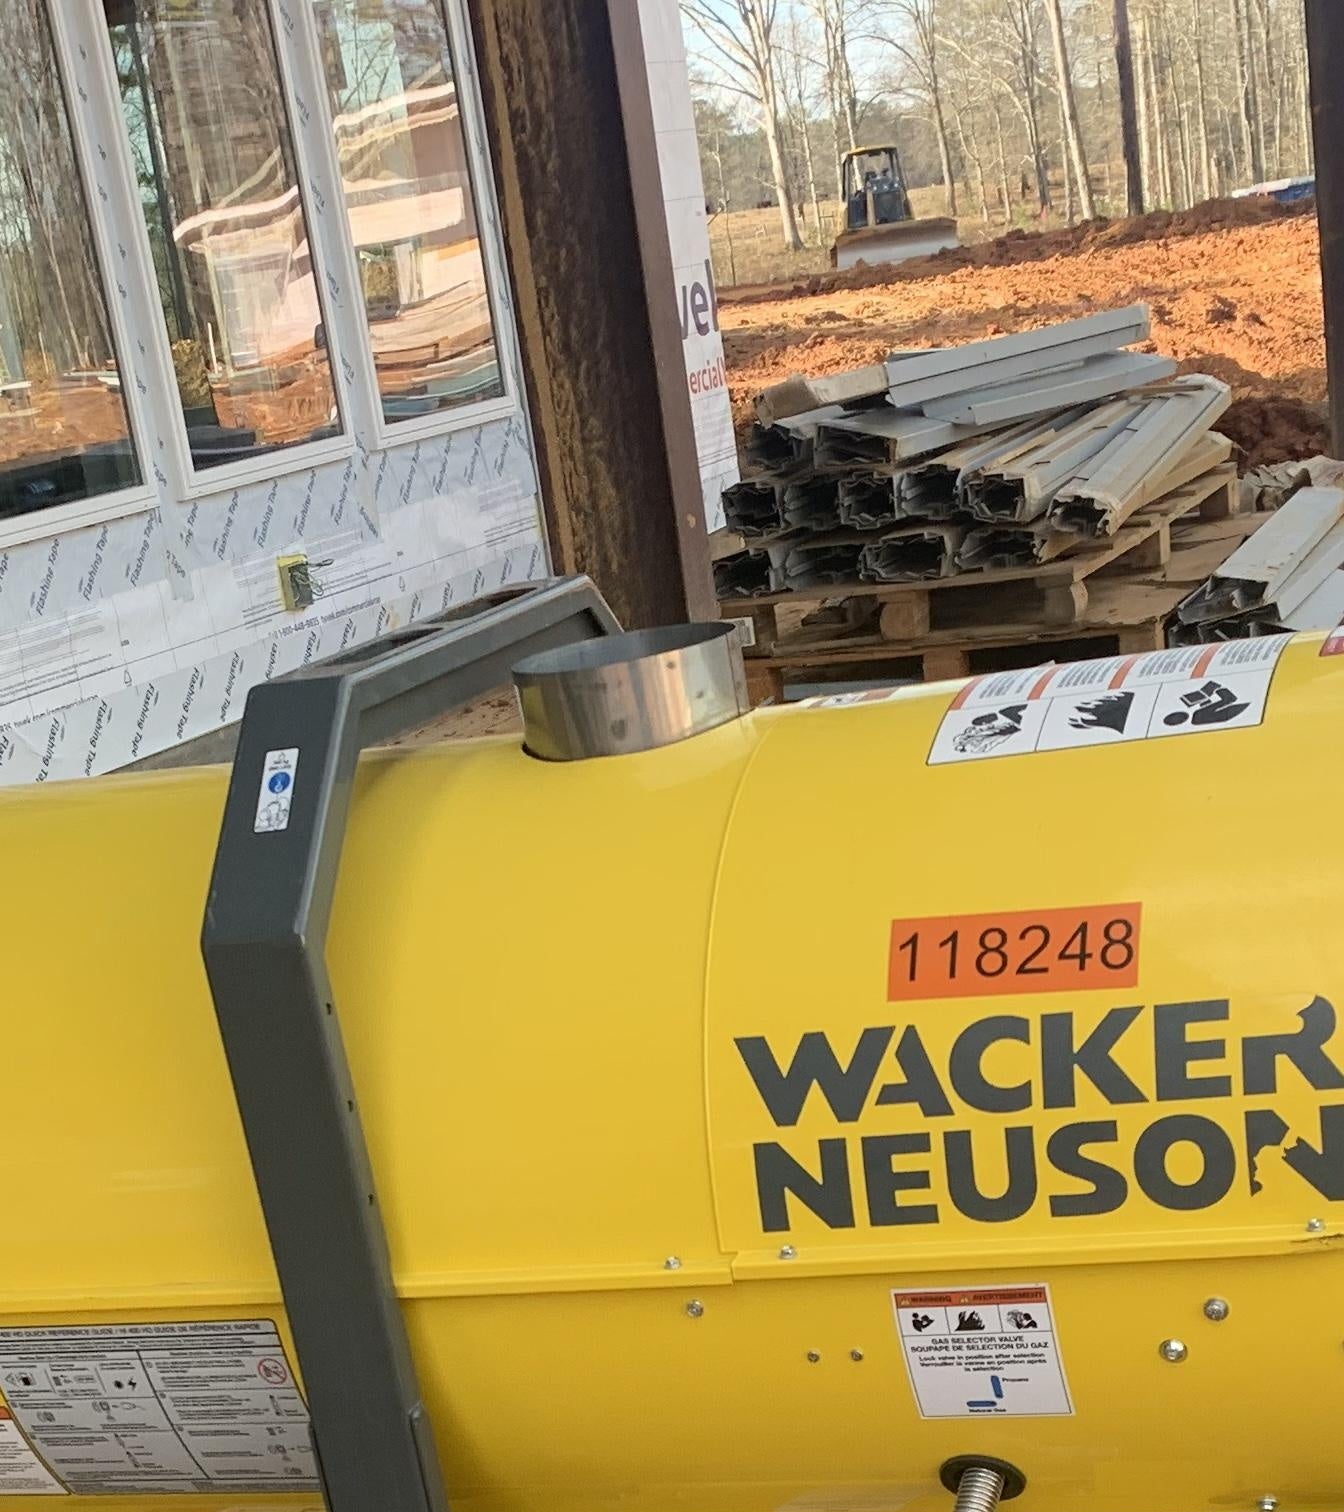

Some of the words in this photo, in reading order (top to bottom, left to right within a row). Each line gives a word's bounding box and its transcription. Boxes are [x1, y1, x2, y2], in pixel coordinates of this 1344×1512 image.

[182, 666, 200, 712] Flashing
[137, 682, 156, 731] Flashing
[89, 699, 108, 748] Flashing
[176, 714, 189, 740] Tape
[42, 717, 61, 767] Flashing
[131, 731, 144, 758] Tape
[84, 749, 97, 777] Tape
[897, 917, 1136, 982] 118248
[952, 1336, 996, 1344] SELECTOR
[1016, 1342, 1028, 1350] DU
[965, 1354, 994, 1362] position
